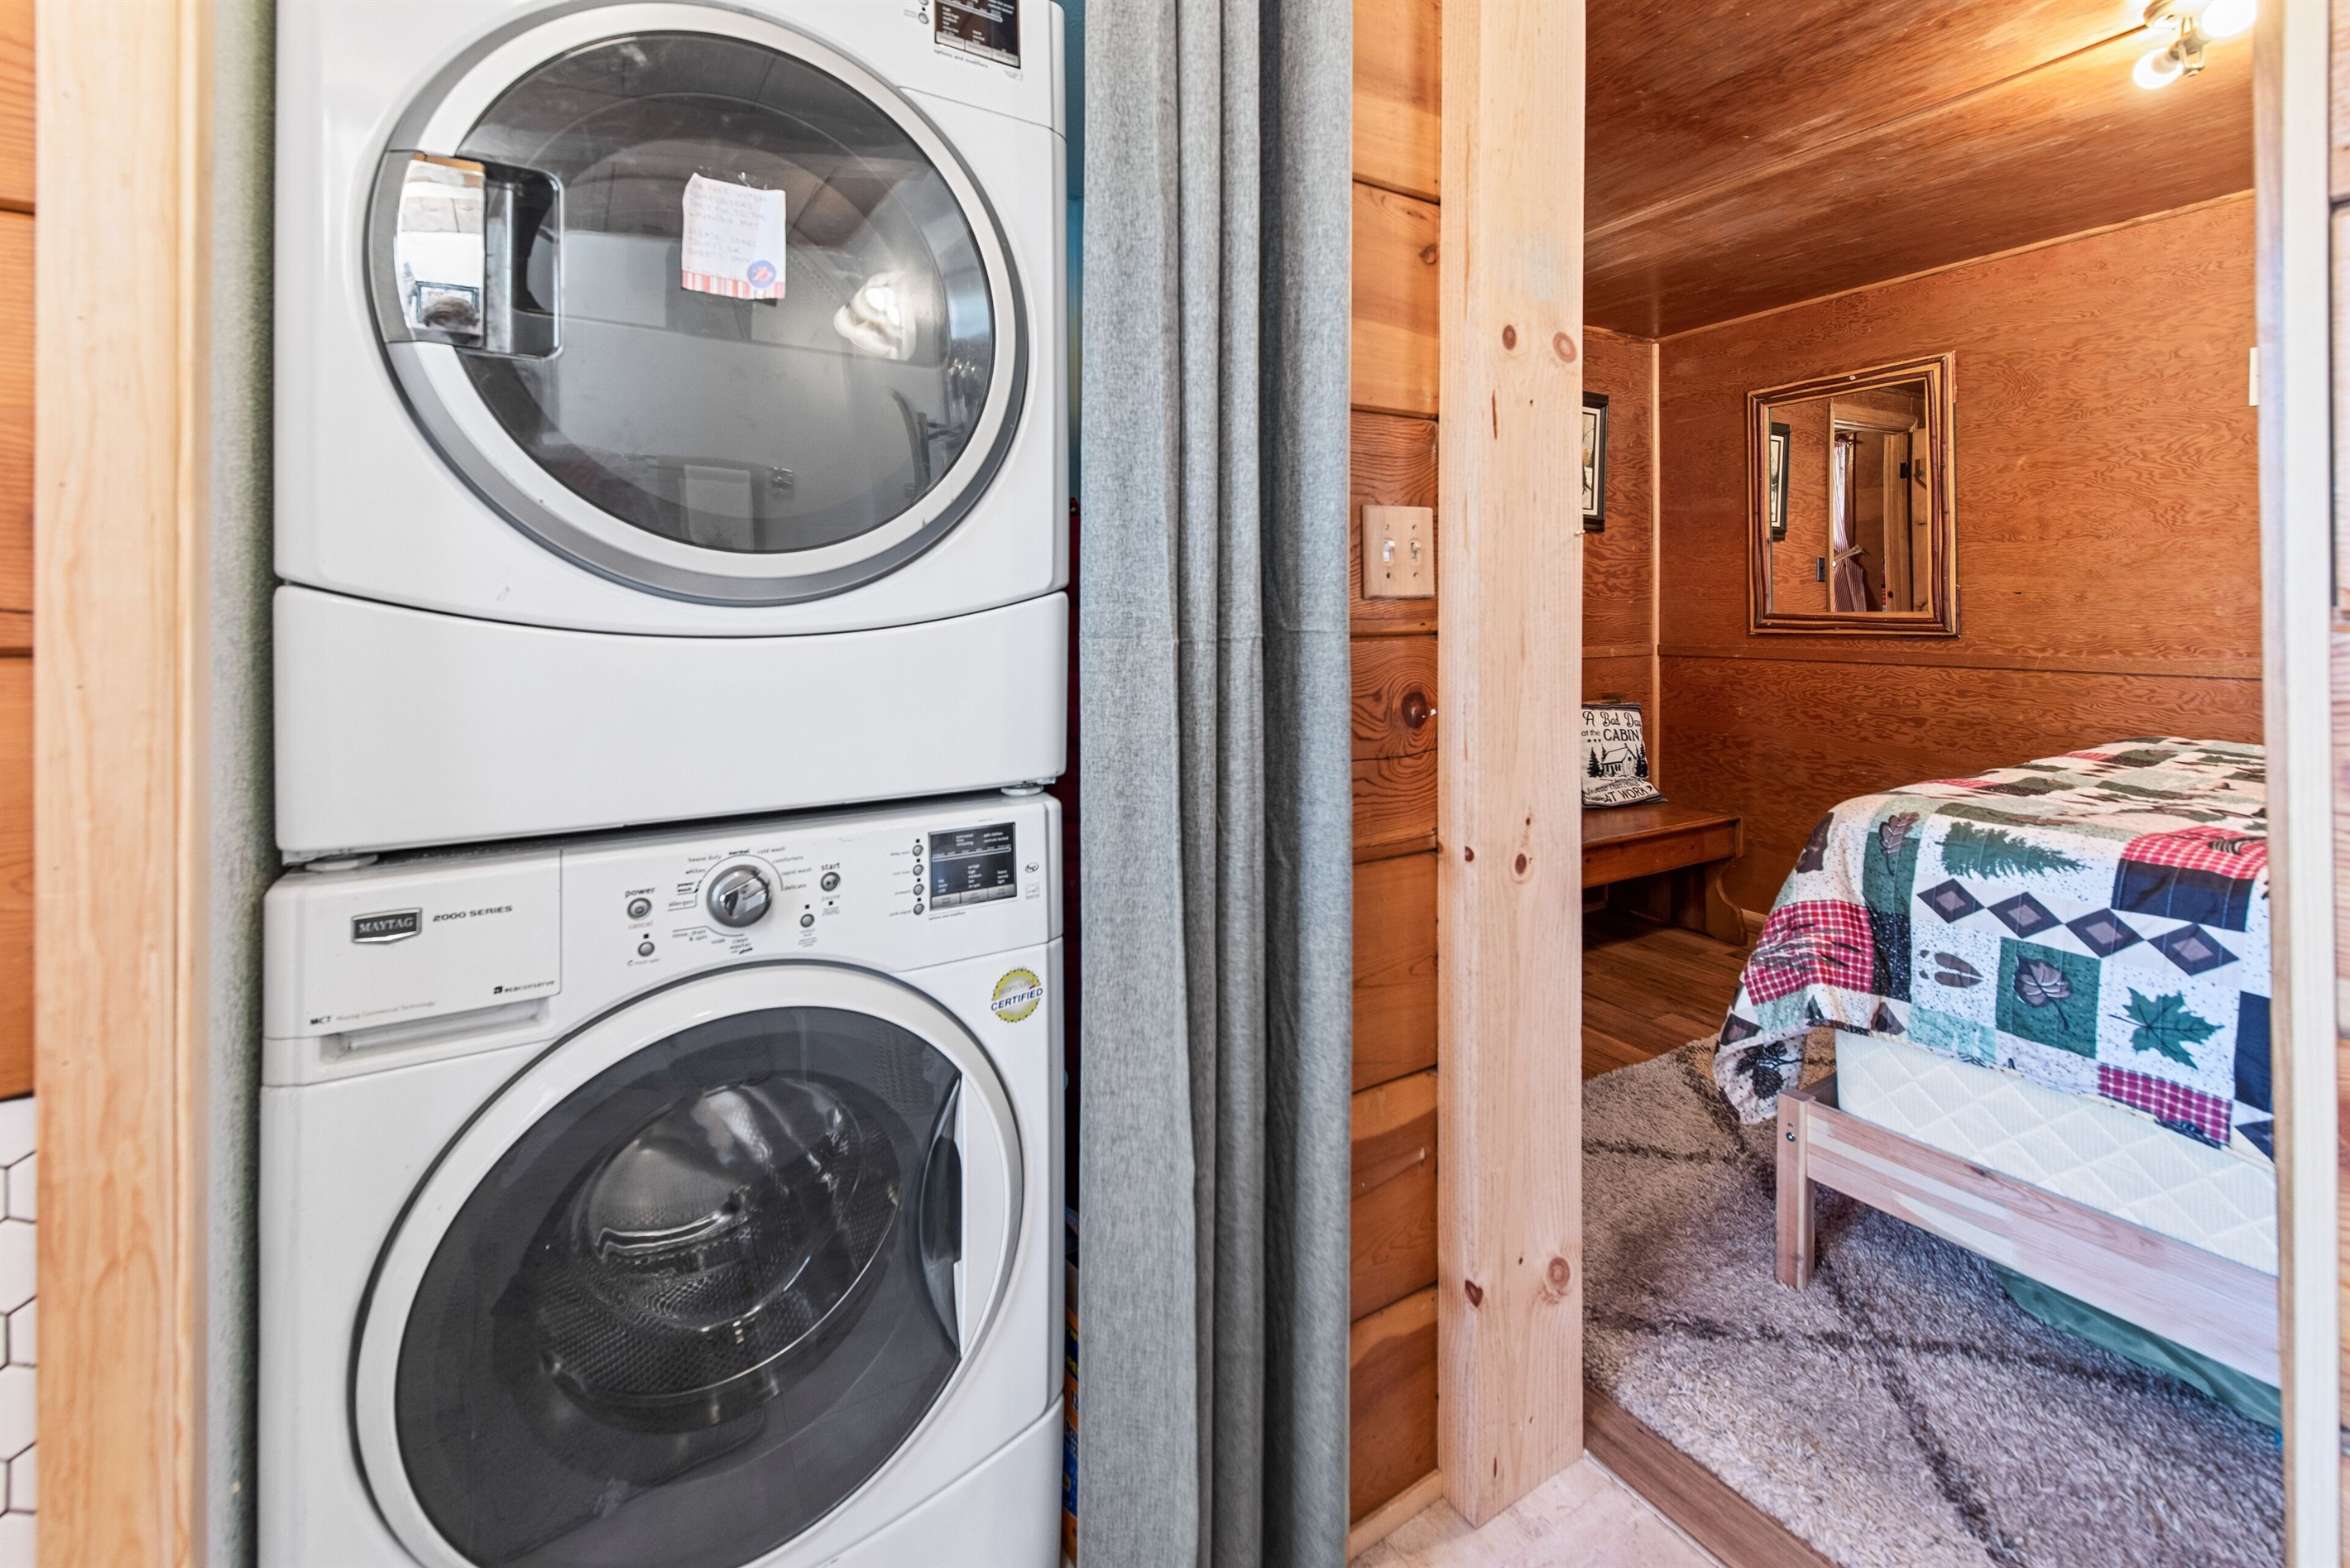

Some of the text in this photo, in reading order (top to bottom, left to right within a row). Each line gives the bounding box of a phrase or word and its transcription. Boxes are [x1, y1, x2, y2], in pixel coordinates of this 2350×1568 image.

[1582, 711, 1595, 726] A
[1600, 712, 1620, 726] Bad
[1603, 729, 1639, 741] CABIN
[1604, 791, 1617, 803] AT
[1618, 787, 1648, 800] WORK
[821, 862, 841, 871] start
[625, 887, 655, 899] power
[433, 905, 512, 922] 2000 SERIES
[358, 916, 414, 933] MAYTAG
[991, 988, 1043, 1011] CERTIFIED
[309, 1015, 332, 1025] MCT
